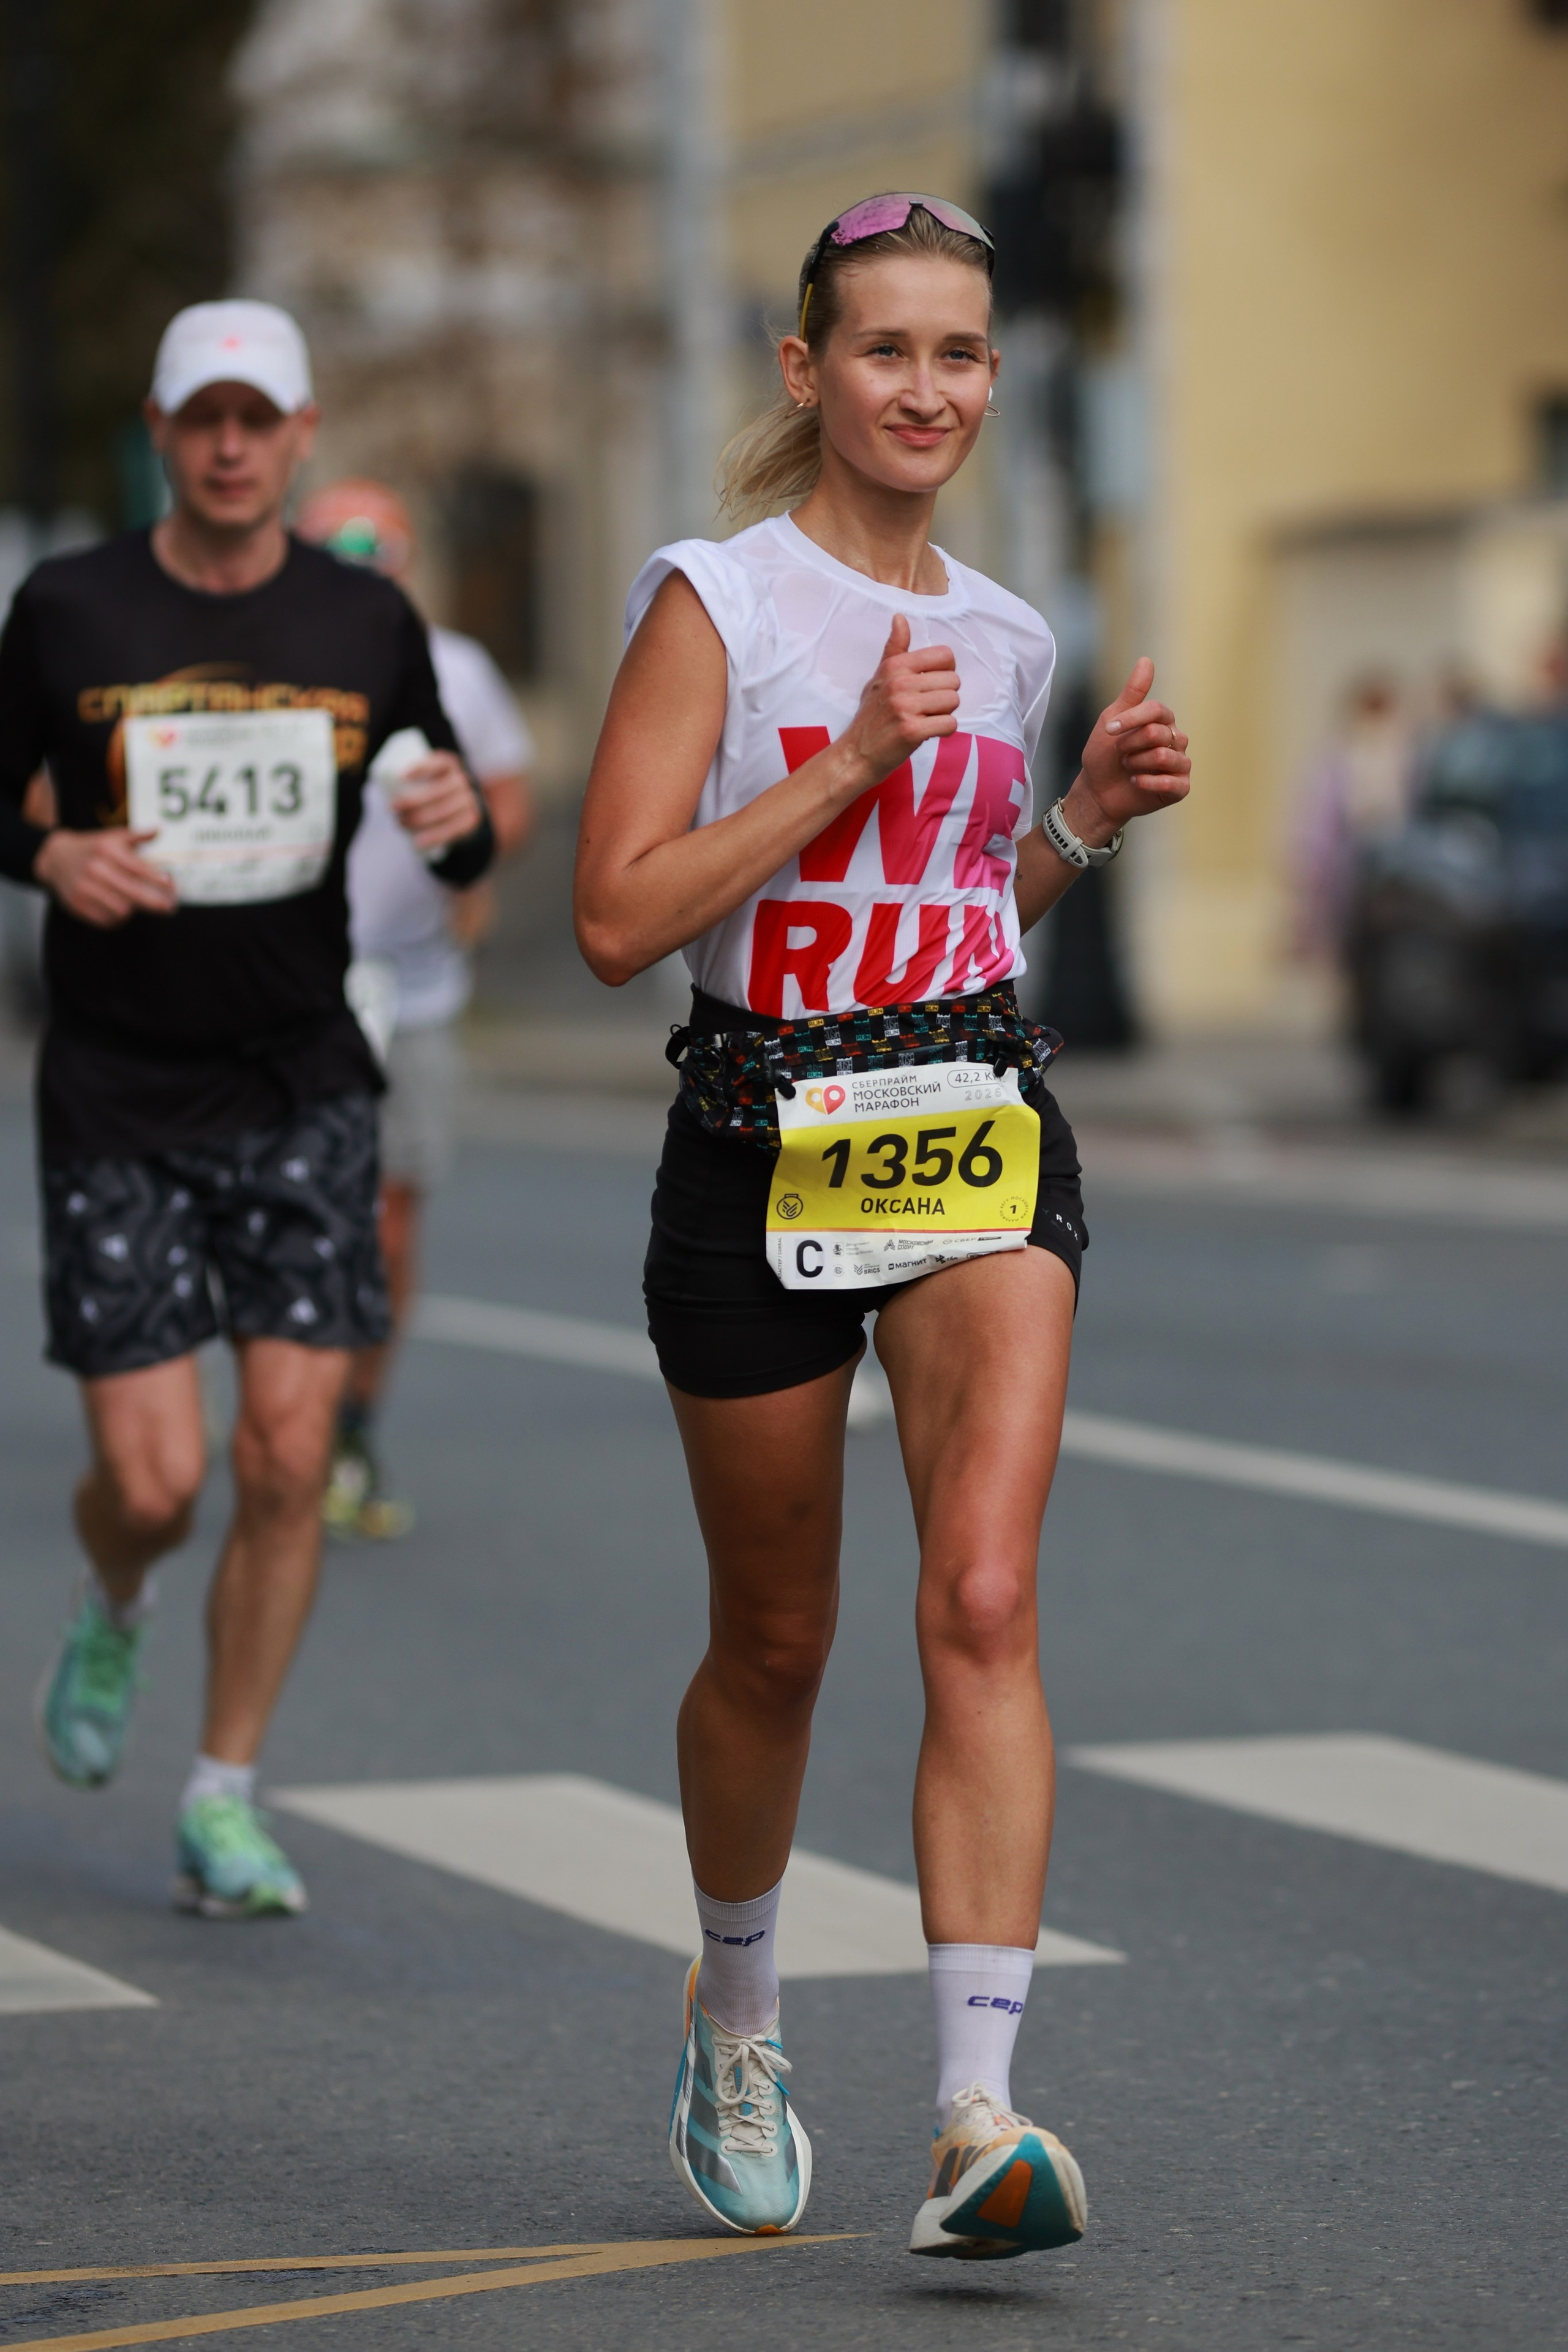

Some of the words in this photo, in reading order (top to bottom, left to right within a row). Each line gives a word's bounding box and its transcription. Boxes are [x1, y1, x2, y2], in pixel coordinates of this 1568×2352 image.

[159, 761, 305, 821] 5413
[778, 726, 1026, 898] WE
[747, 897, 1014, 1020] RUN
[867, 1008, 884, 1016] RUN
[808, 1018, 824, 1028] RUN
[884, 1028, 900, 1037] RUN
[1038, 1047, 1051, 1062] RUN
[1022, 1060, 1033, 1068] RUN
[851, 1074, 918, 1089] СБЕРПРАЙМ
[955, 1072, 981, 1084] 42,2
[853, 1081, 941, 1101] МОСКОВСКИЙ
[964, 1087, 1001, 1101] 2026
[855, 1097, 919, 1113] МАРАФОН
[821, 1120, 1003, 1189] 1356
[861, 1197, 945, 1215] ОКСАНА
[1009, 1204, 1017, 1214] 1
[704, 1928, 765, 1947] cep
[967, 1994, 1024, 2016] cep
